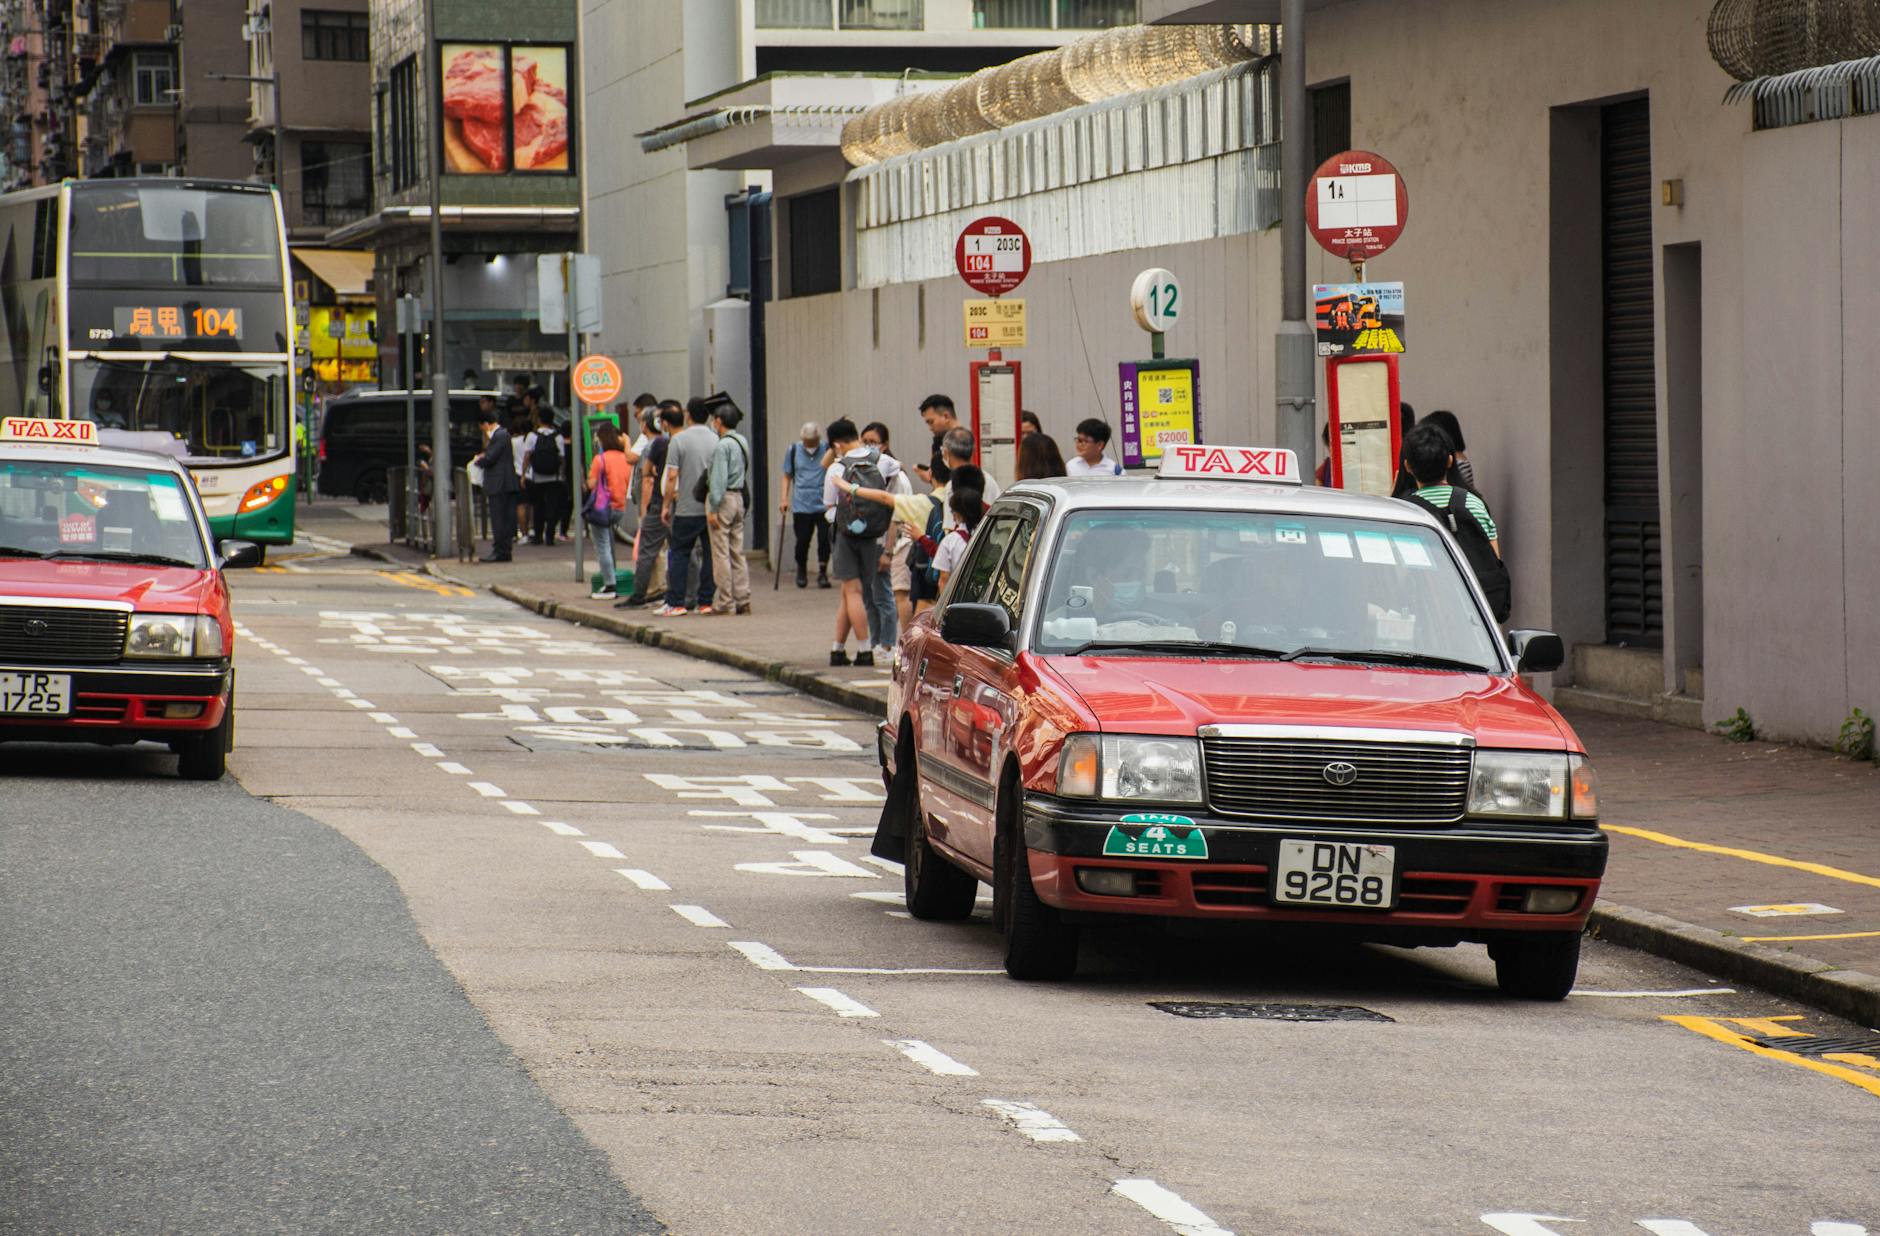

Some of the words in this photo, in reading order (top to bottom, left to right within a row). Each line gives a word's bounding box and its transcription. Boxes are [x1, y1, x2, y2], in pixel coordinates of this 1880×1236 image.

[1328, 180, 1344, 200] 1A
[975, 238, 980, 252] 1
[997, 238, 1021, 251] 203C
[969, 255, 990, 270] 104
[1150, 283, 1177, 317] 12
[193, 308, 238, 336] 104
[89, 328, 113, 339] 5729
[971, 329, 987, 337] 104
[582, 371, 612, 386] 69A
[8, 420, 91, 440] TAXI
[1158, 431, 1188, 443] $2000
[1176, 447, 1287, 476] TAXI
[17, 673, 48, 693] TR
[3, 692, 61, 712] 1725
[457, 704, 843, 726] STOP
[513, 725, 863, 751] BUS
[1146, 825, 1166, 841] 4
[1126, 842, 1187, 855] SEATS
[1312, 843, 1361, 875] DN
[1285, 870, 1383, 905] 9268
